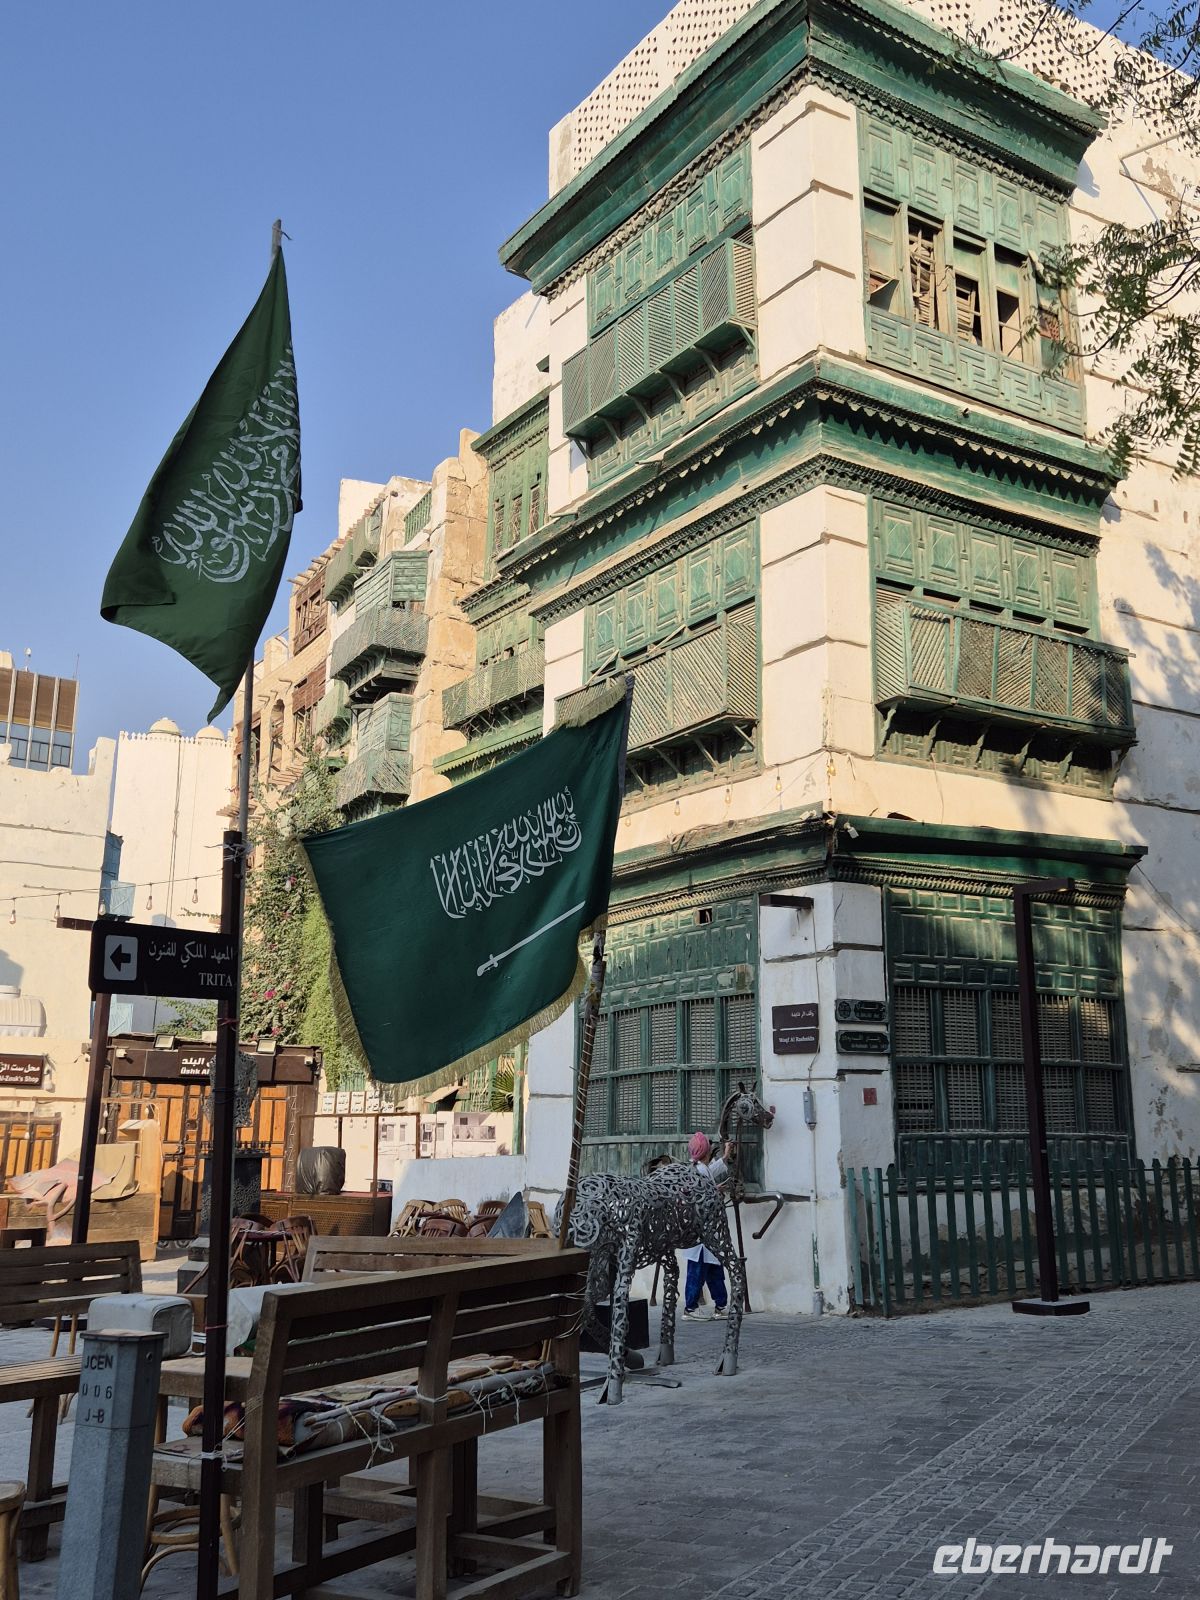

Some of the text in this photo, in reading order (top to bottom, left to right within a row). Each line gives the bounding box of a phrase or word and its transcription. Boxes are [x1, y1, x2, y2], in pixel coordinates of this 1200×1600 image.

[148, 940, 233, 968] المعهد الملكي للفنون
[198, 972, 233, 987] TRITA
[23, 1063, 40, 1073] محل
[181, 1057, 205, 1067] البلد
[24, 1075, 40, 1084] Shop
[84, 1354, 114, 1370] JCEN
